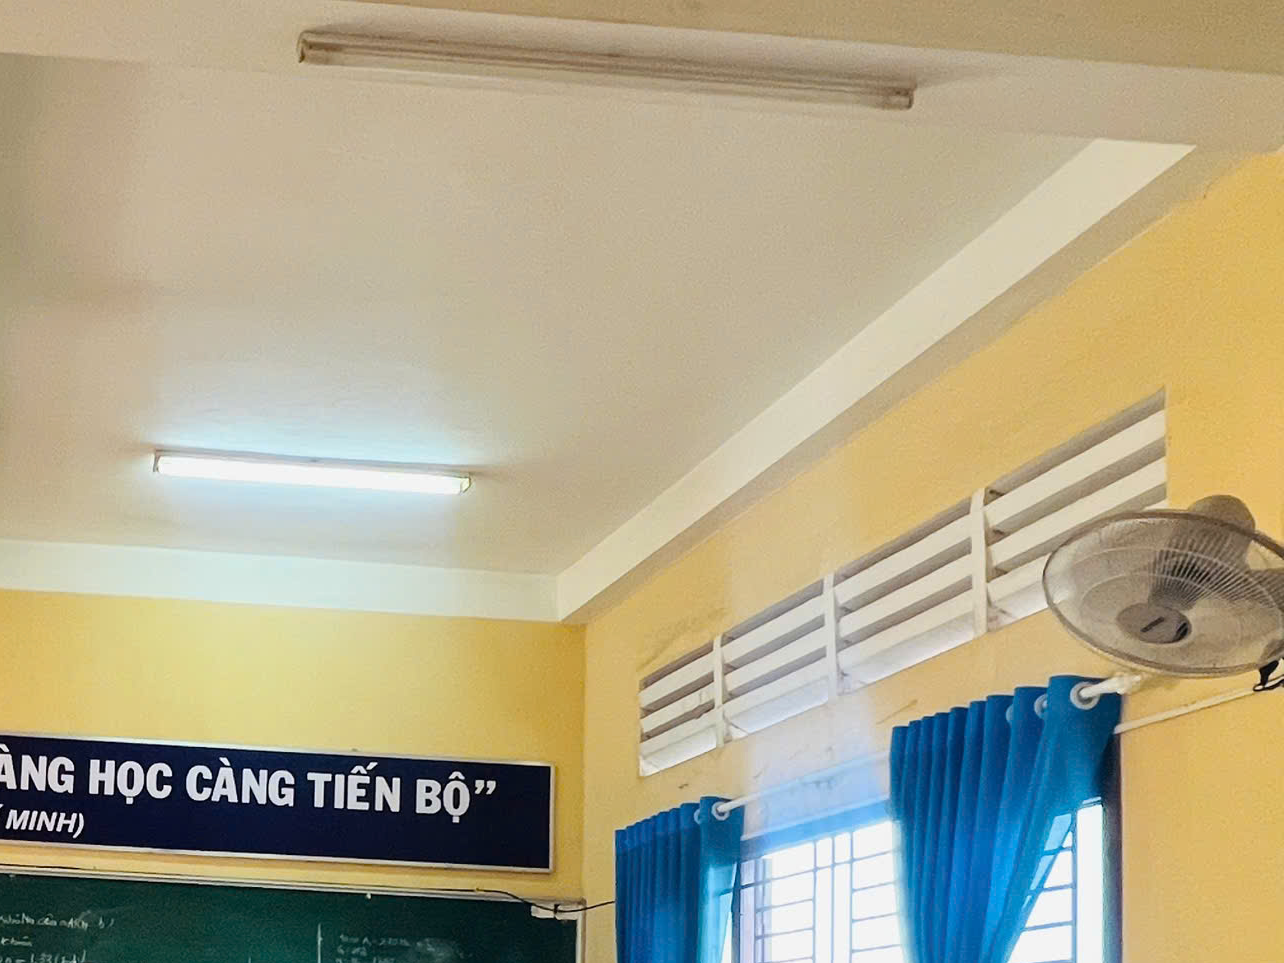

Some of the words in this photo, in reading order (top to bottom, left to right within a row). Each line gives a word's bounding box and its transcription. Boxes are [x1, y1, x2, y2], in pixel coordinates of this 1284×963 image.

[88, 758, 173, 805] HỌC
[185, 757, 295, 807] CÀNG
[307, 761, 401, 812] TIẾN
[5, 810, 85, 839] MINH)
